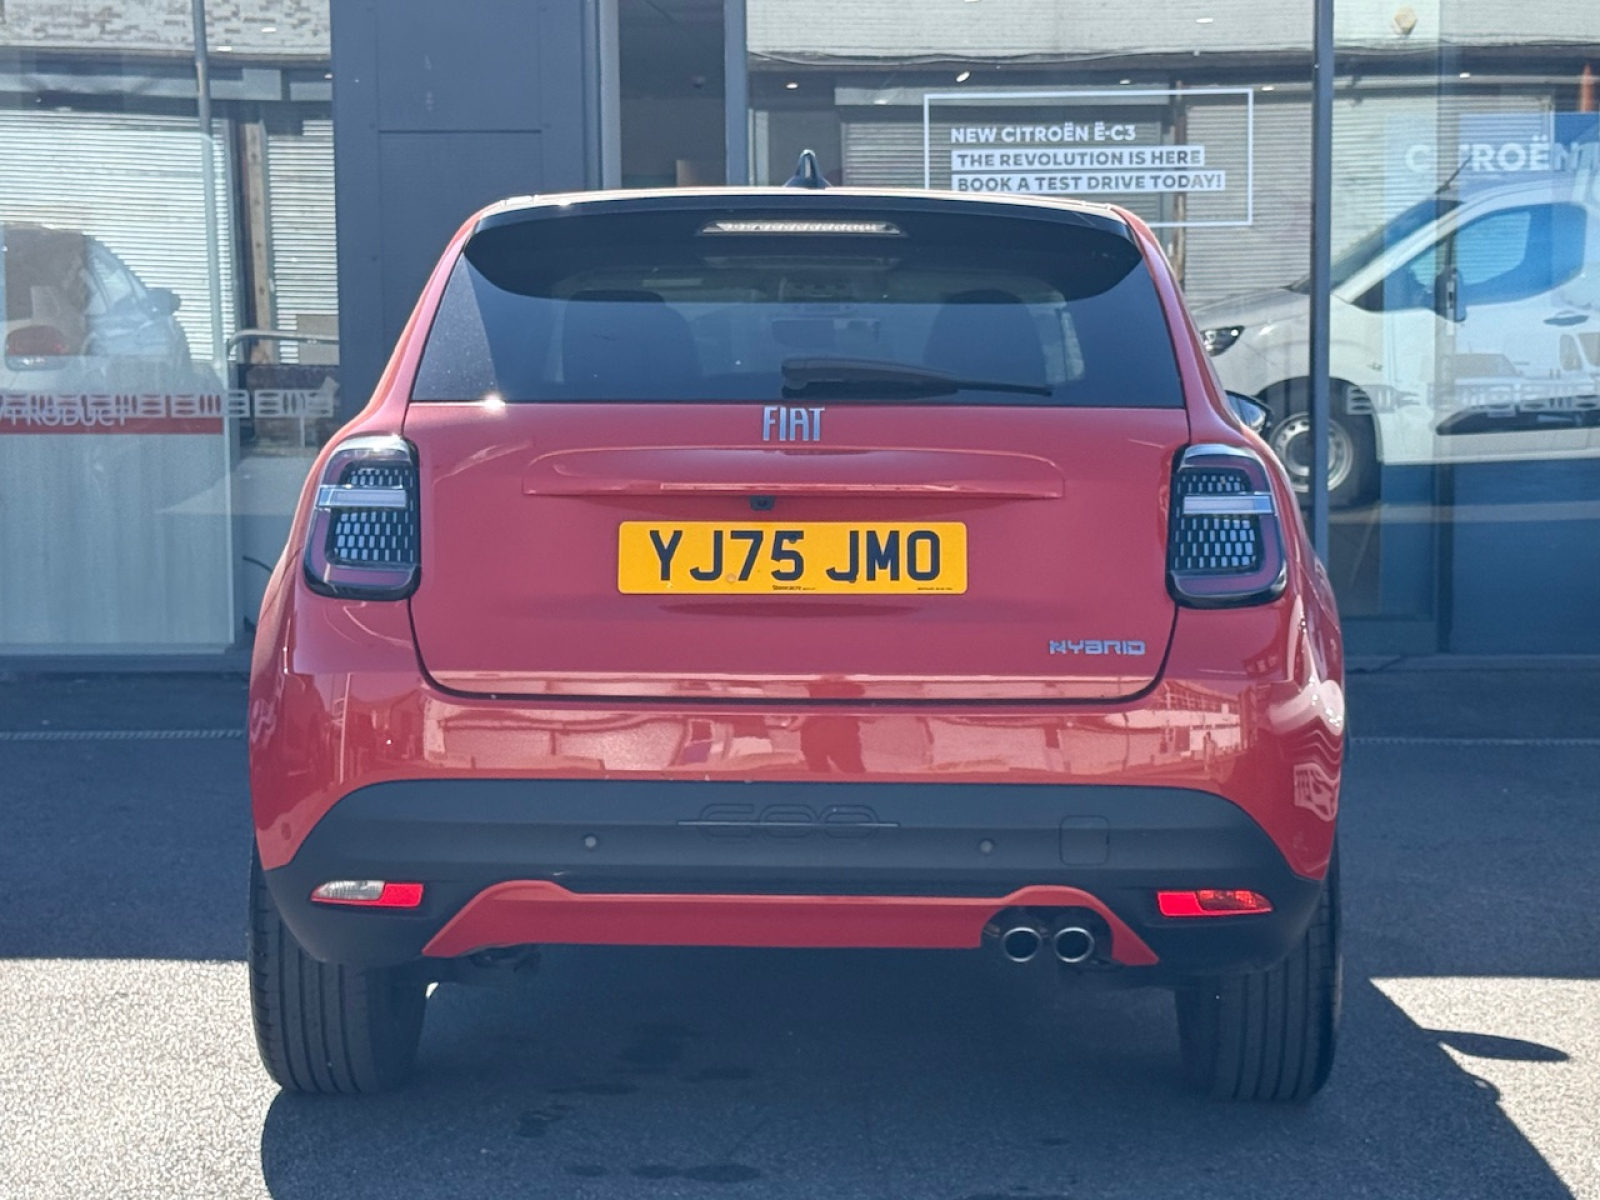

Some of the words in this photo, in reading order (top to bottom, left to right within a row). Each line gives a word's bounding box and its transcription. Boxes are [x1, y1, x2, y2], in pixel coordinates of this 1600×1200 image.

[951, 127, 997, 143] NEW
[1001, 121, 1089, 142] CITROËN
[957, 154, 995, 167] THE
[1000, 151, 1124, 166] REVOLUTION
[1129, 151, 1146, 165] IS
[1151, 150, 1201, 165] HERE
[1405, 135, 1578, 172] CROËN
[958, 178, 1011, 191] BOOK
[1017, 177, 1030, 191] A
[1035, 176, 1082, 190] TEST
[1087, 175, 1146, 190] DRIVE
[1149, 174, 1222, 189] TODAY!
[763, 406, 826, 442] FIAT
[649, 530, 805, 582] YJ75
[825, 530, 941, 582] JMO
[1048, 640, 1146, 655] HYBRID
